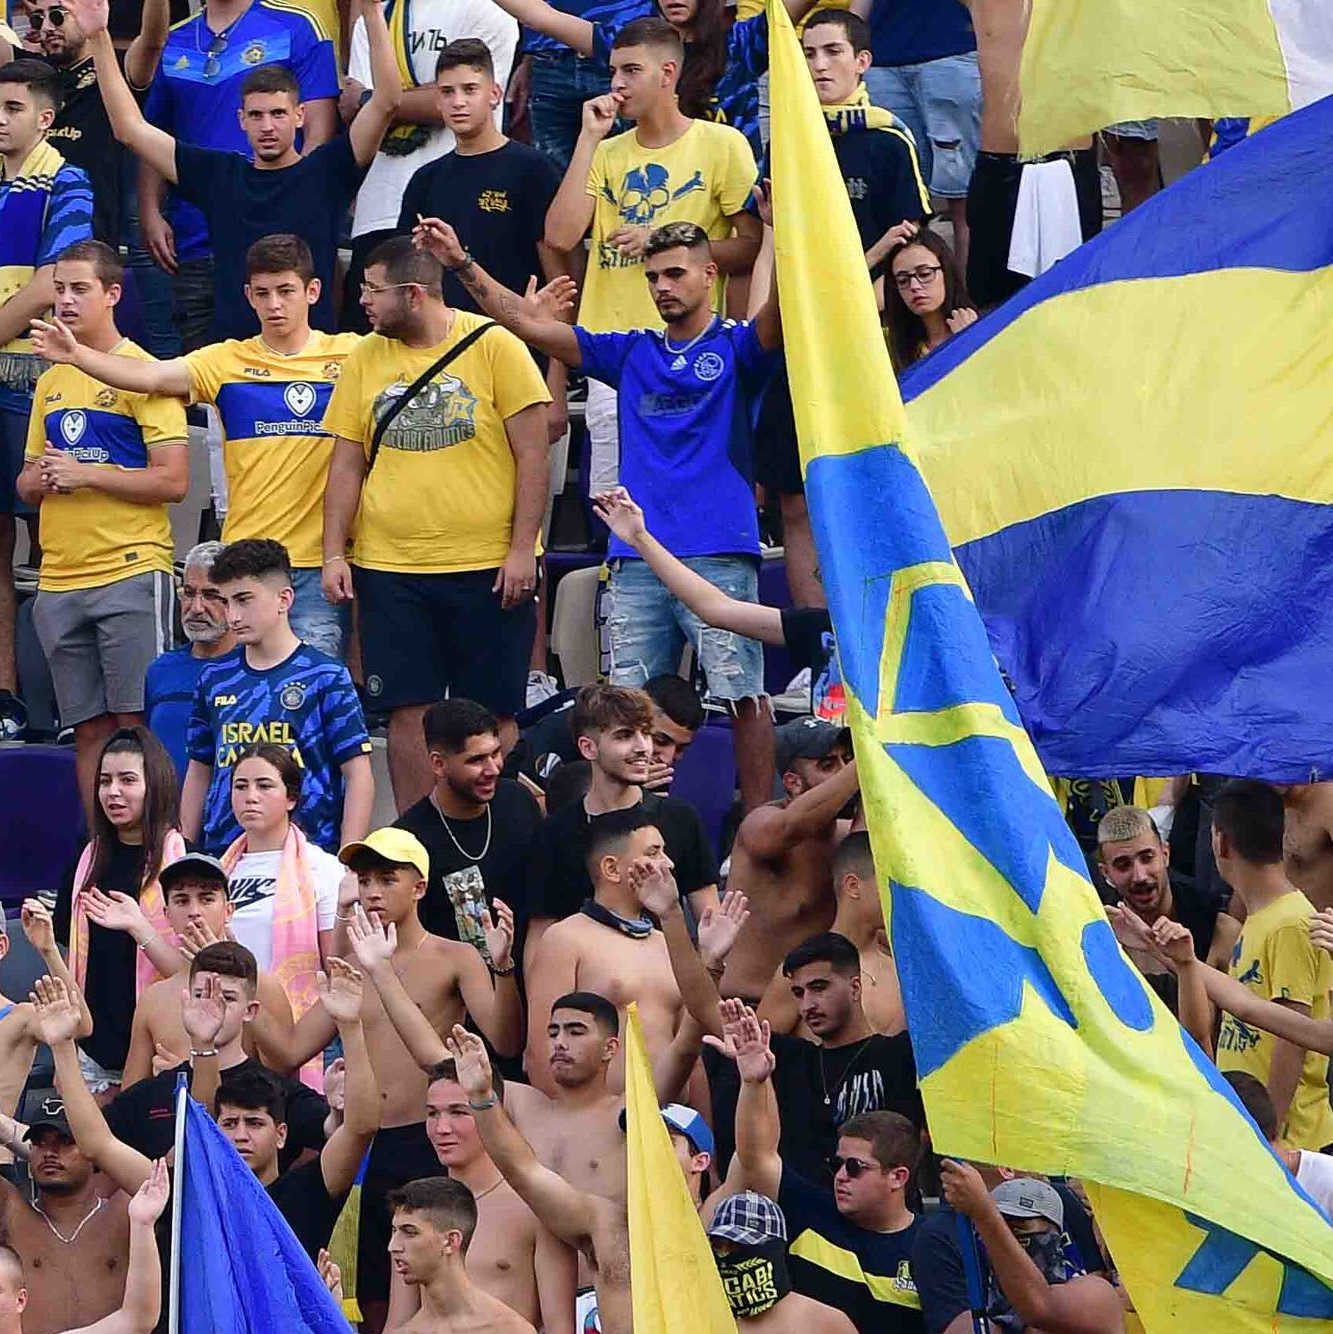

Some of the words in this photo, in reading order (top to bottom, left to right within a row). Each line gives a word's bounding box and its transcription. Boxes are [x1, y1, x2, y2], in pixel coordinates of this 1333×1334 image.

[244, 367, 271, 377] FILA
[214, 694, 237, 707] FILA
[221, 721, 295, 745] ISRAEL
